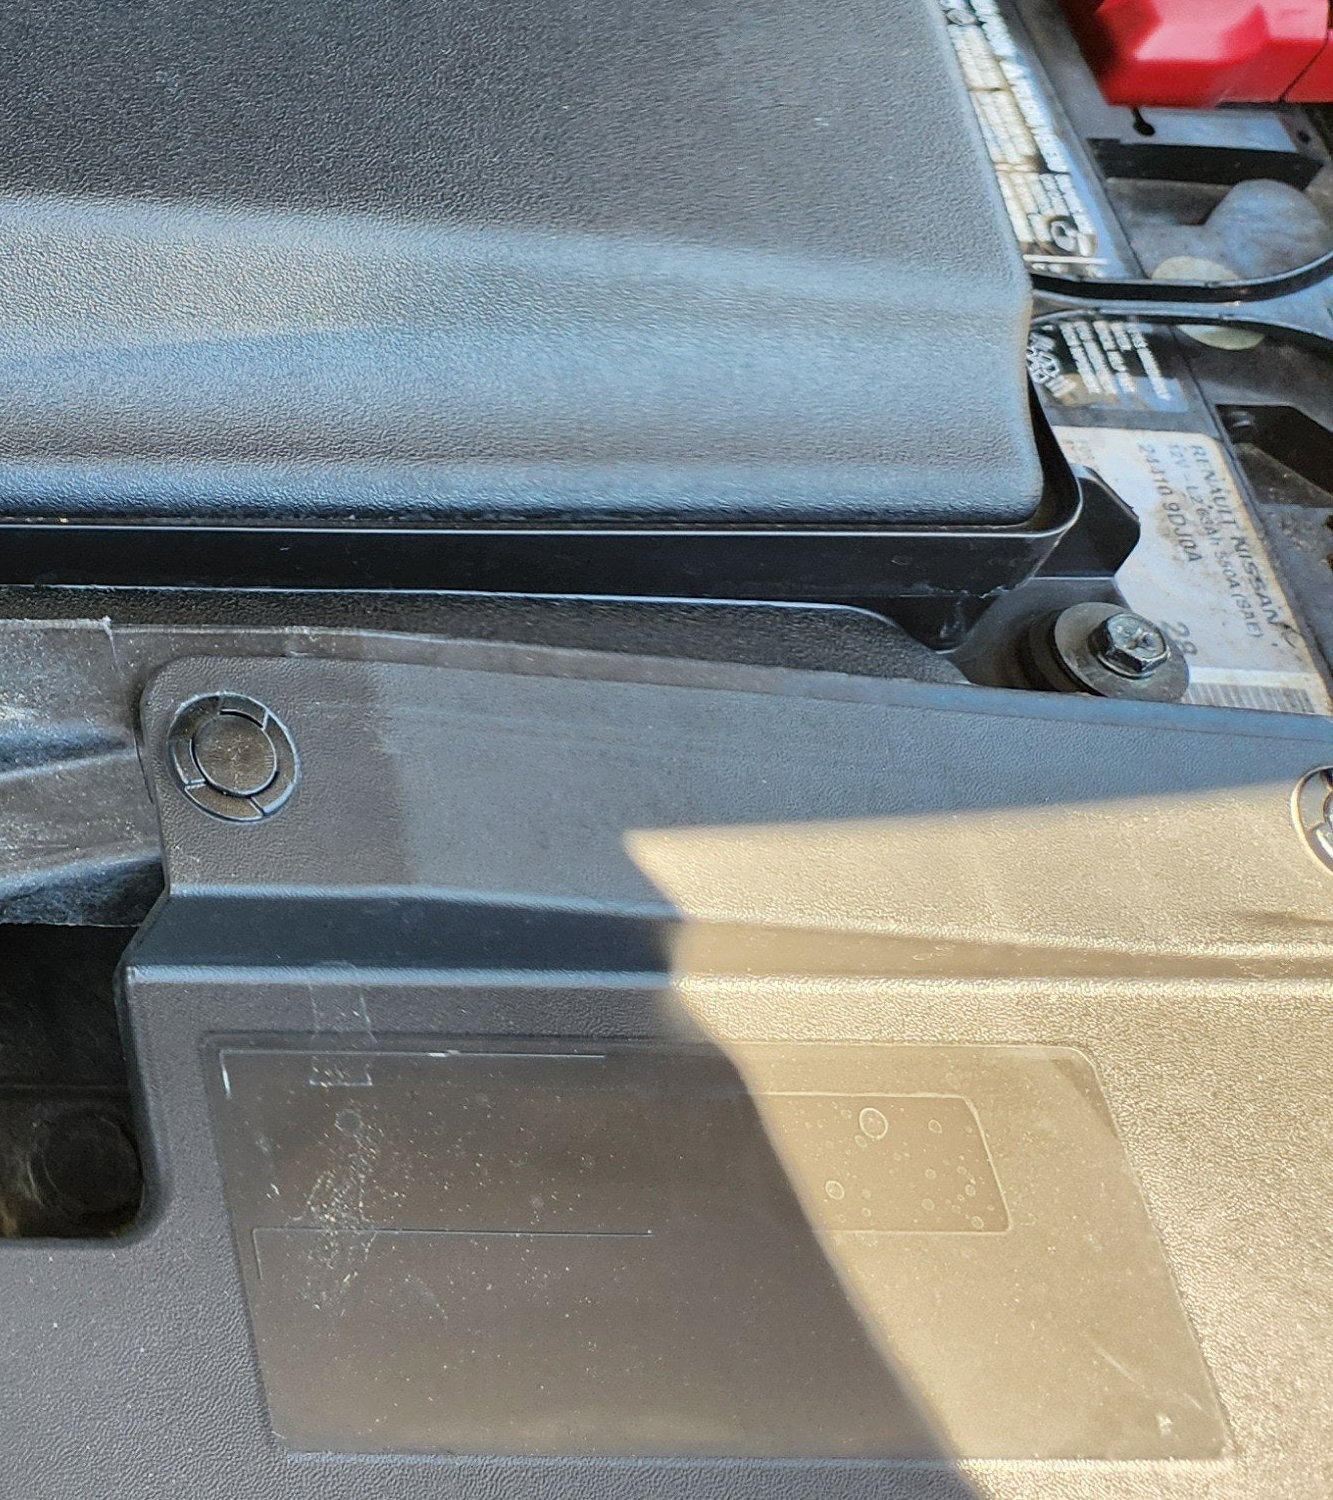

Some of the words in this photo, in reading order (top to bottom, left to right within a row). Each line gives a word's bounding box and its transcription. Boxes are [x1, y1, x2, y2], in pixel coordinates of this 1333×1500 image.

[1190, 444, 1239, 530] RENAULT
[1231, 535, 1280, 626] NISSAN
[1231, 592, 1263, 639] (SAE)
